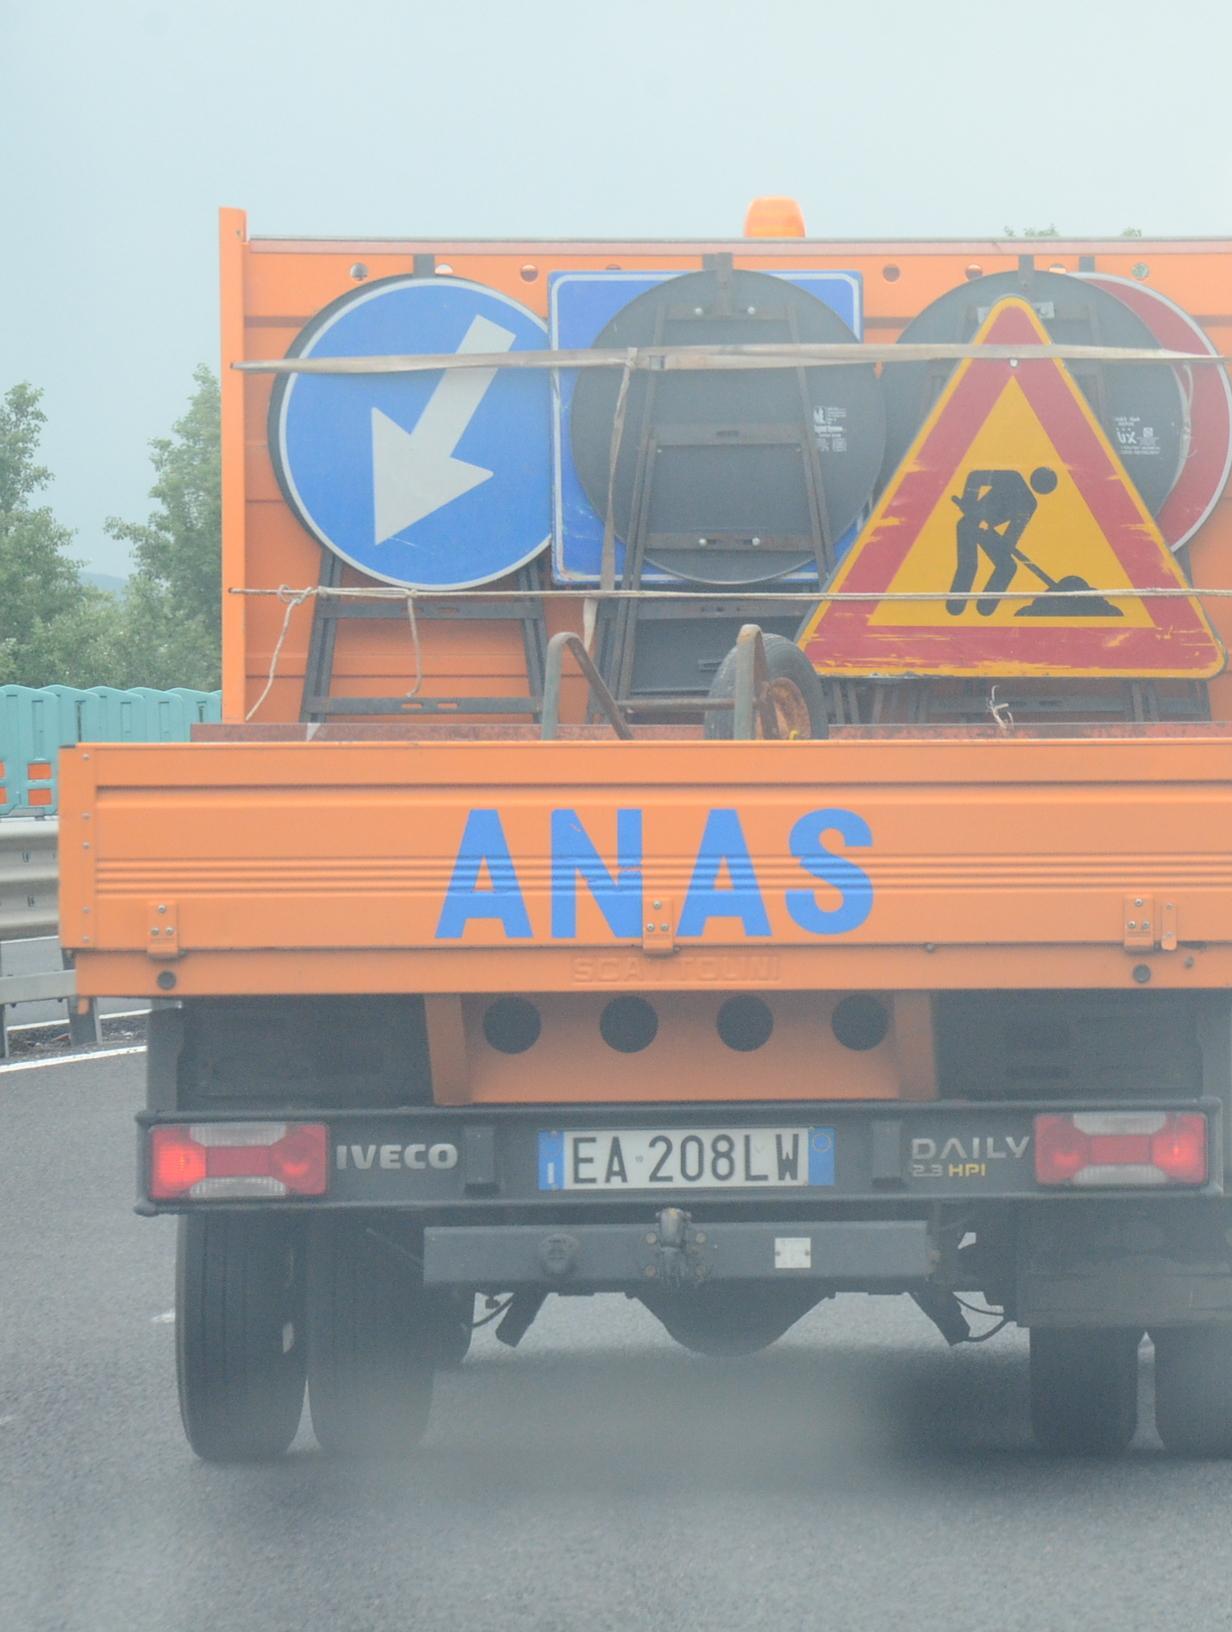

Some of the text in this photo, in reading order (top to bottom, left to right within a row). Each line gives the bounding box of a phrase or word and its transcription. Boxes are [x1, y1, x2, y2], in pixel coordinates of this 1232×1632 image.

[434, 808, 874, 938] ANAS
[336, 1143, 458, 1170] IVECO
[912, 1136, 1030, 1160] DAILY
[949, 1163, 986, 1177] HPI
